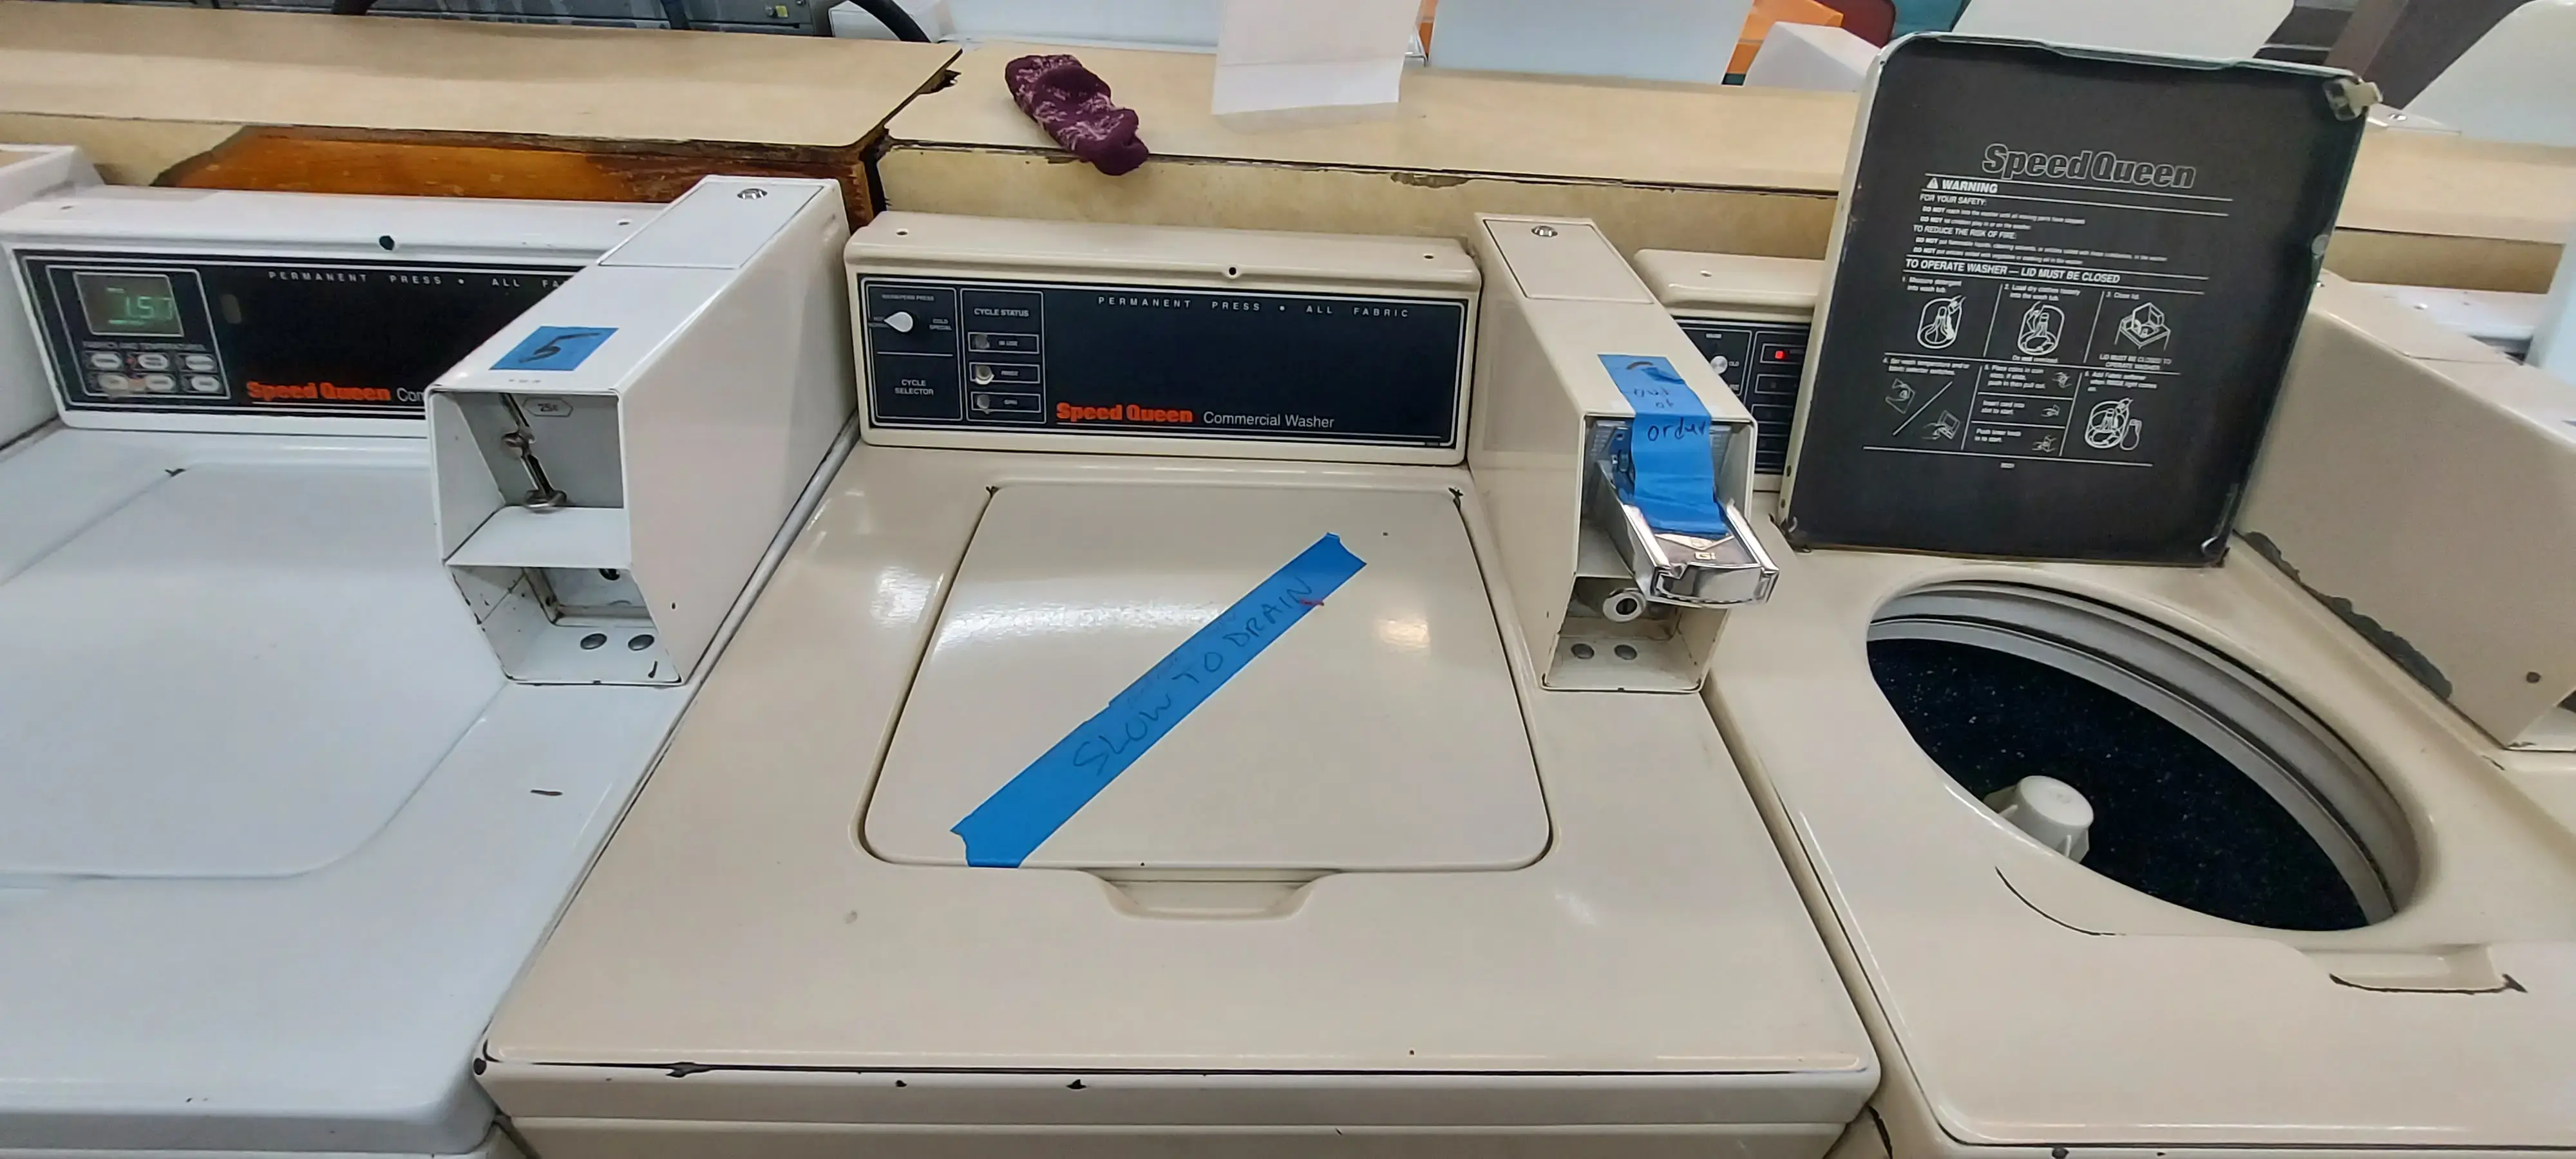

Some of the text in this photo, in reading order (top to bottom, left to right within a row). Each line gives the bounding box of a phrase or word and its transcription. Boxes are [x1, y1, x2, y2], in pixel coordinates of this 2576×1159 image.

[1982, 143, 2196, 189] Speed Queen
[1942, 179, 1998, 193] WARNING
[1937, 195, 1957, 203] YOUR
[1957, 196, 1987, 205] SAFETY:
[1924, 226, 1954, 235] REDUCE
[1955, 227, 1969, 236] THE
[269, 271, 565, 288] PERMANENT PRESS ALL FA
[1906, 259, 1919, 269] TO
[1920, 259, 1965, 272] OPERATE
[1966, 263, 2008, 275] WASHER
[2020, 266, 2037, 277] LID
[2038, 268, 2065, 279] MUST
[2065, 271, 2081, 281] BE
[2081, 272, 2121, 283] CLOSED
[1001, 309, 1029, 317] STATUS
[1098, 297, 1409, 317] PERMANENT PRESS ALL FABRIC
[518, 332, 602, 363] 5
[247, 381, 319, 402] Speed
[319, 382, 391, 401] Queen
[901, 379, 927, 388] CYCLE
[1056, 402, 1335, 429] Speed Queen Commercial Washer
[1072, 576, 1313, 777] SLOW TO DRAIN
